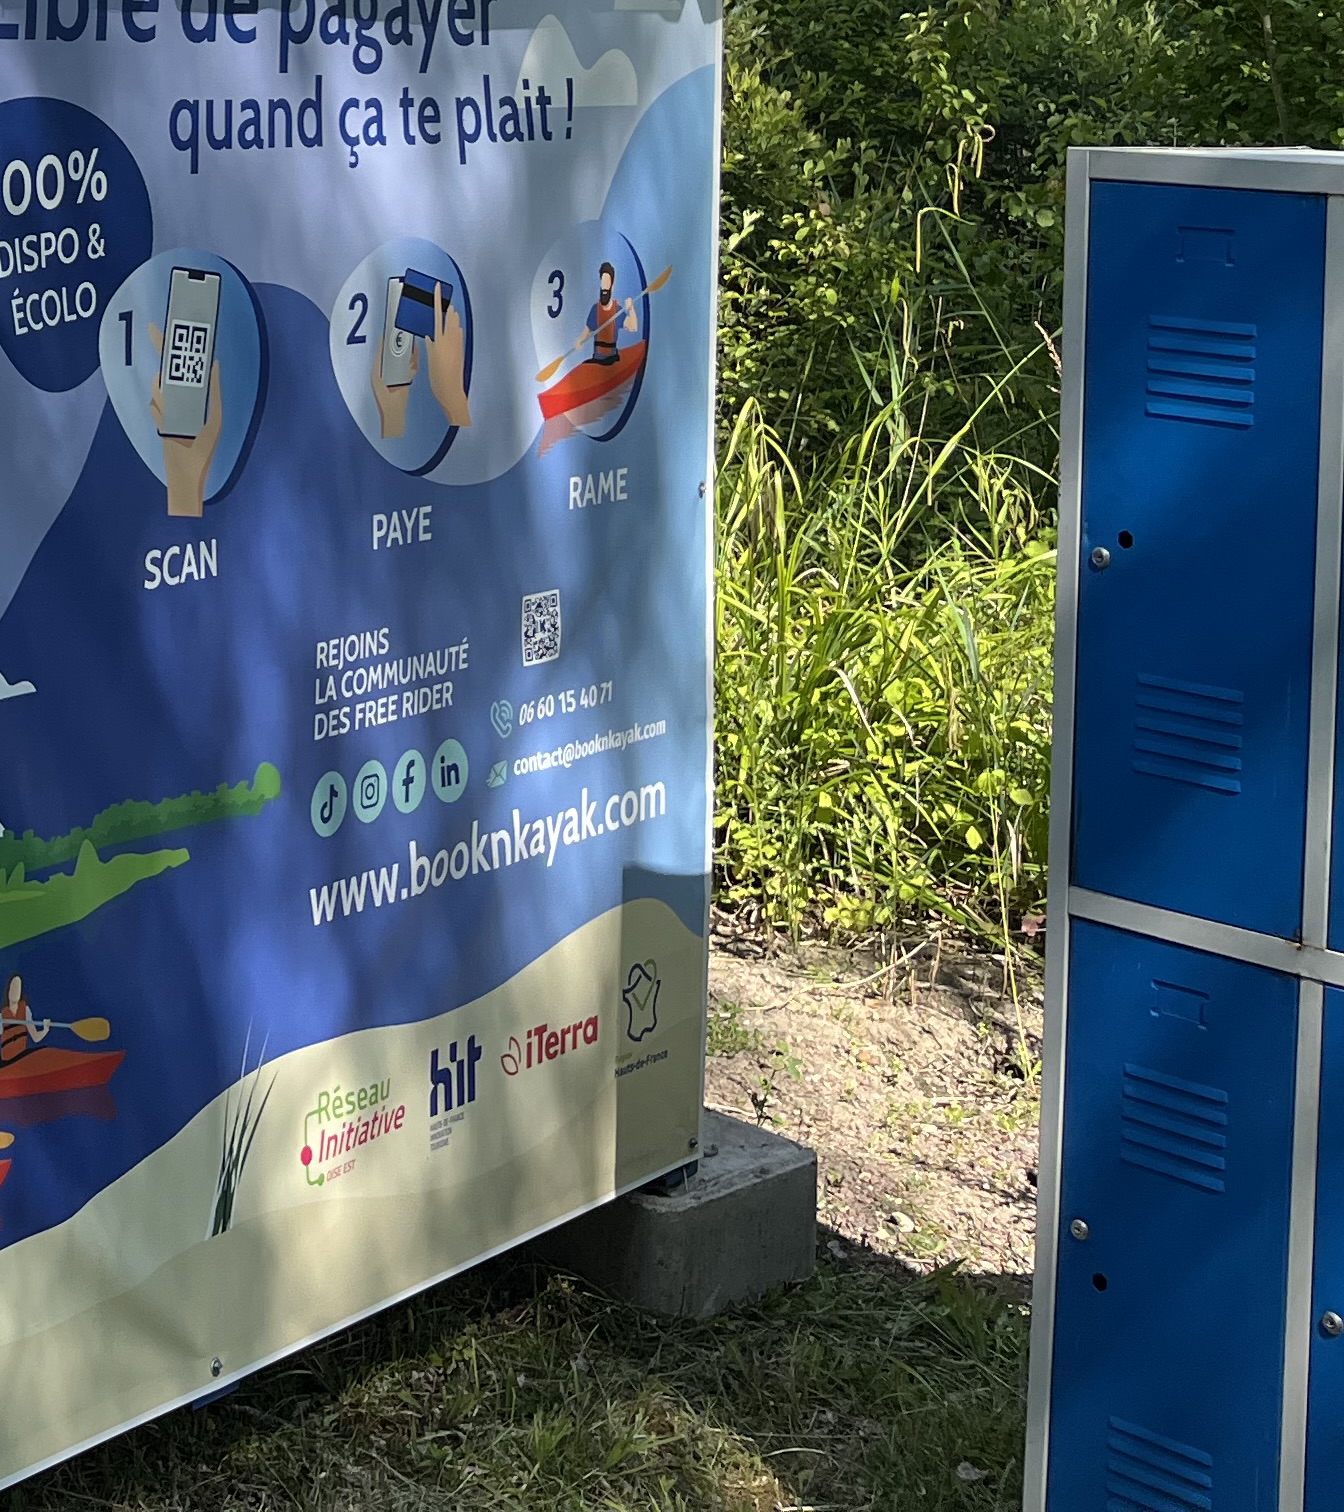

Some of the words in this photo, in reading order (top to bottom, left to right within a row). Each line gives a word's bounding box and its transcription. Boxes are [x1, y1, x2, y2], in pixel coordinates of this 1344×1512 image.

[168, 74, 323, 175] quand
[338, 97, 387, 168] ça
[399, 86, 442, 146] te
[455, 74, 553, 165] plait
[564, 77, 574, 140] !
[86, 223, 106, 260] &
[10, 281, 97, 336] ÉCOLO
[345, 292, 369, 346] 2
[546, 269, 566, 319] 3
[118, 310, 134, 366] 1
[568, 467, 629, 510] RAME
[372, 504, 433, 550] PAYE
[143, 538, 218, 590] SCAN
[315, 675, 338, 705] LA
[341, 636, 470, 698] COMMUNAUTÉ
[316, 627, 390, 670] REJOINS
[313, 706, 351, 741] DES
[354, 694, 399, 731] FREE
[402, 681, 454, 718] RIDER
[518, 699, 535, 726] 06
[536, 694, 555, 720] 60
[558, 689, 577, 714] 15
[579, 684, 598, 709] 40
[599, 679, 613, 705] 71
[513, 718, 667, 769] contact@booknkayak.com
[309, 780, 667, 927] www.booknkayak.com
[525, 1014, 599, 1070] iTerra
[317, 1077, 392, 1125] Réseau
[430, 1034, 483, 1118] hit
[318, 1103, 406, 1164] Initiative
[342, 1158, 357, 1175] EST
